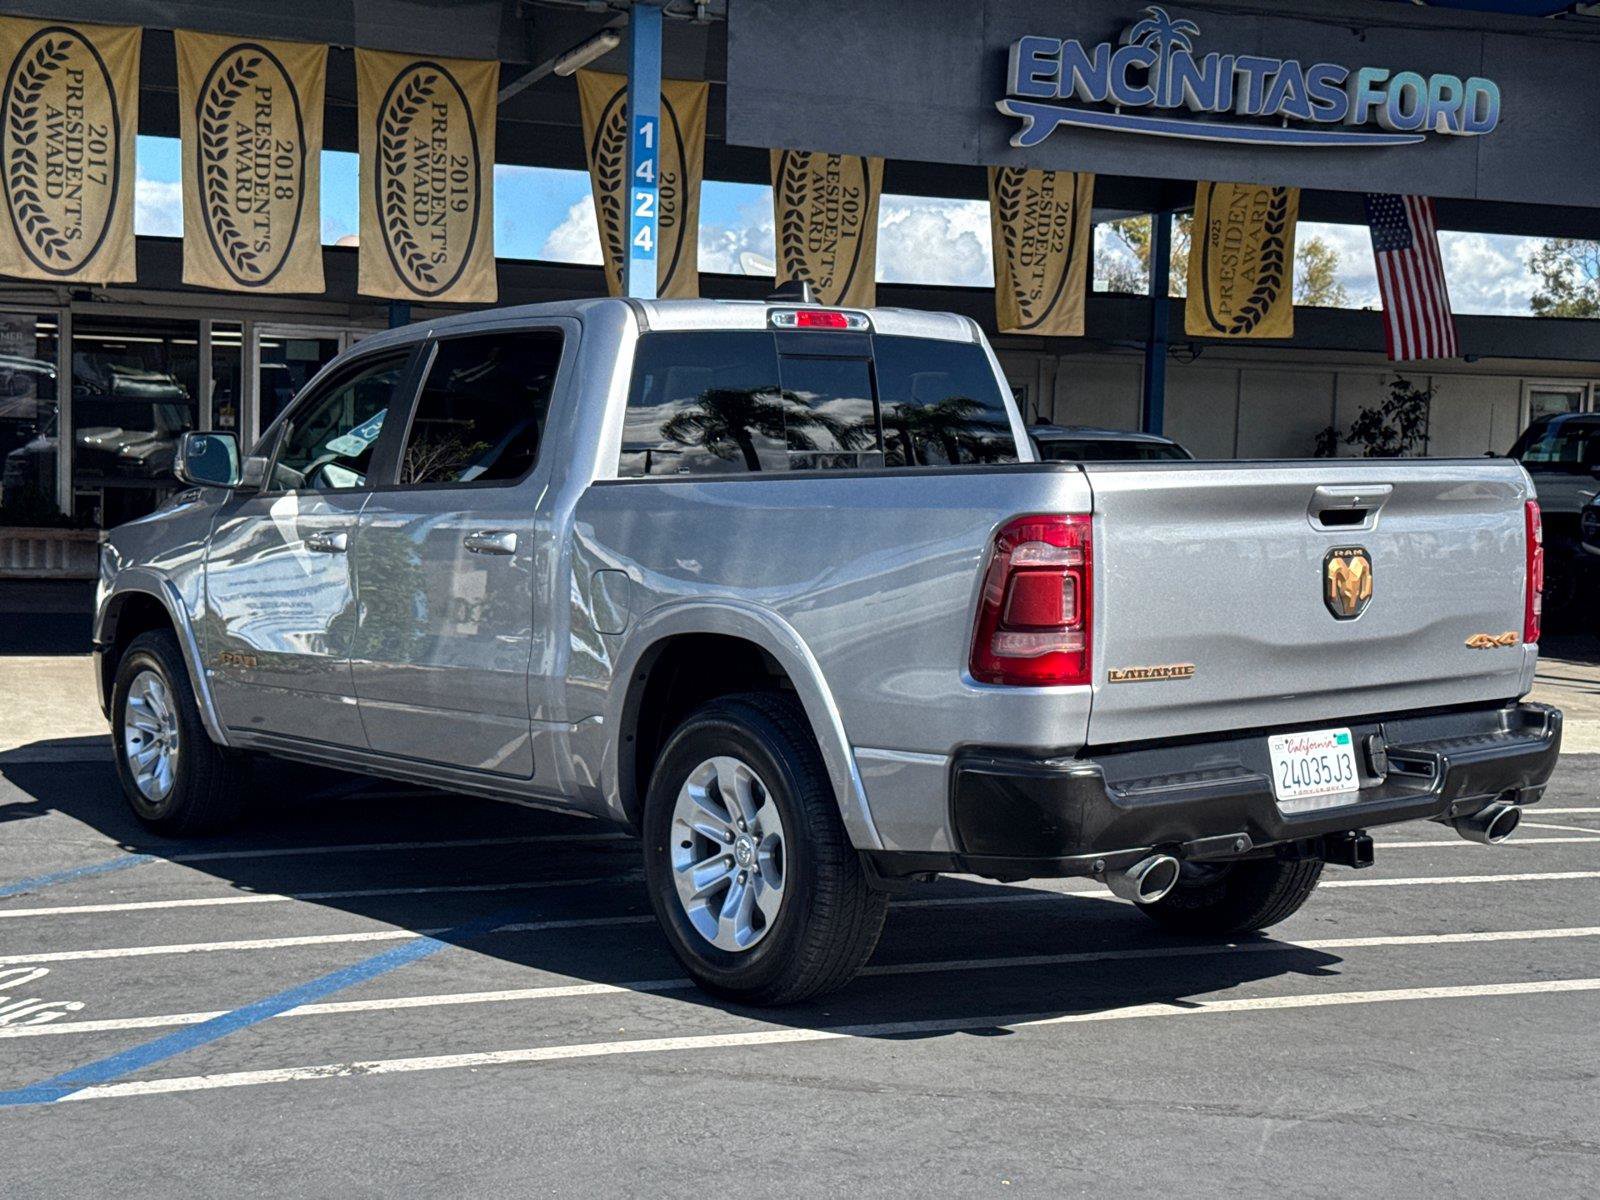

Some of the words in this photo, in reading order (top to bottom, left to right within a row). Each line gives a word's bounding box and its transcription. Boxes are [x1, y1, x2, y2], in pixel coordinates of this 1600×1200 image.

[1006, 5, 1350, 123] ENCINITAS
[1346, 67, 1500, 136] FORD
[44, 103, 65, 199] AWARD
[64, 67, 85, 241] PRESIDENT'S
[88, 124, 108, 186] 2017
[235, 122, 252, 214] AWARD
[253, 86, 273, 253] PRESIDENT'S
[274, 140, 294, 201] 2018
[412, 137, 430, 227] AWARD
[430, 103, 448, 265] PRESIDENT'S
[450, 154, 469, 213] 2019
[633, 121, 655, 252] 1424
[658, 171, 676, 228] 2020
[808, 170, 826, 253] AWARD
[820, 154, 841, 288] RESIDENT'S
[841, 187, 859, 238] 2021
[1020, 186, 1039, 267] AWARD
[1029, 170, 1056, 300] RESIDENT'S
[1049, 202, 1070, 253] 2022
[1211, 219, 1222, 247] 2025
[1241, 190, 1269, 284] AWARD
[1218, 184, 1250, 316] PRESIDEN
[1107, 663, 1195, 683] LARAMIE
[1280, 753, 1353, 789] 24035J3
[1287, 736, 1337, 755] California
